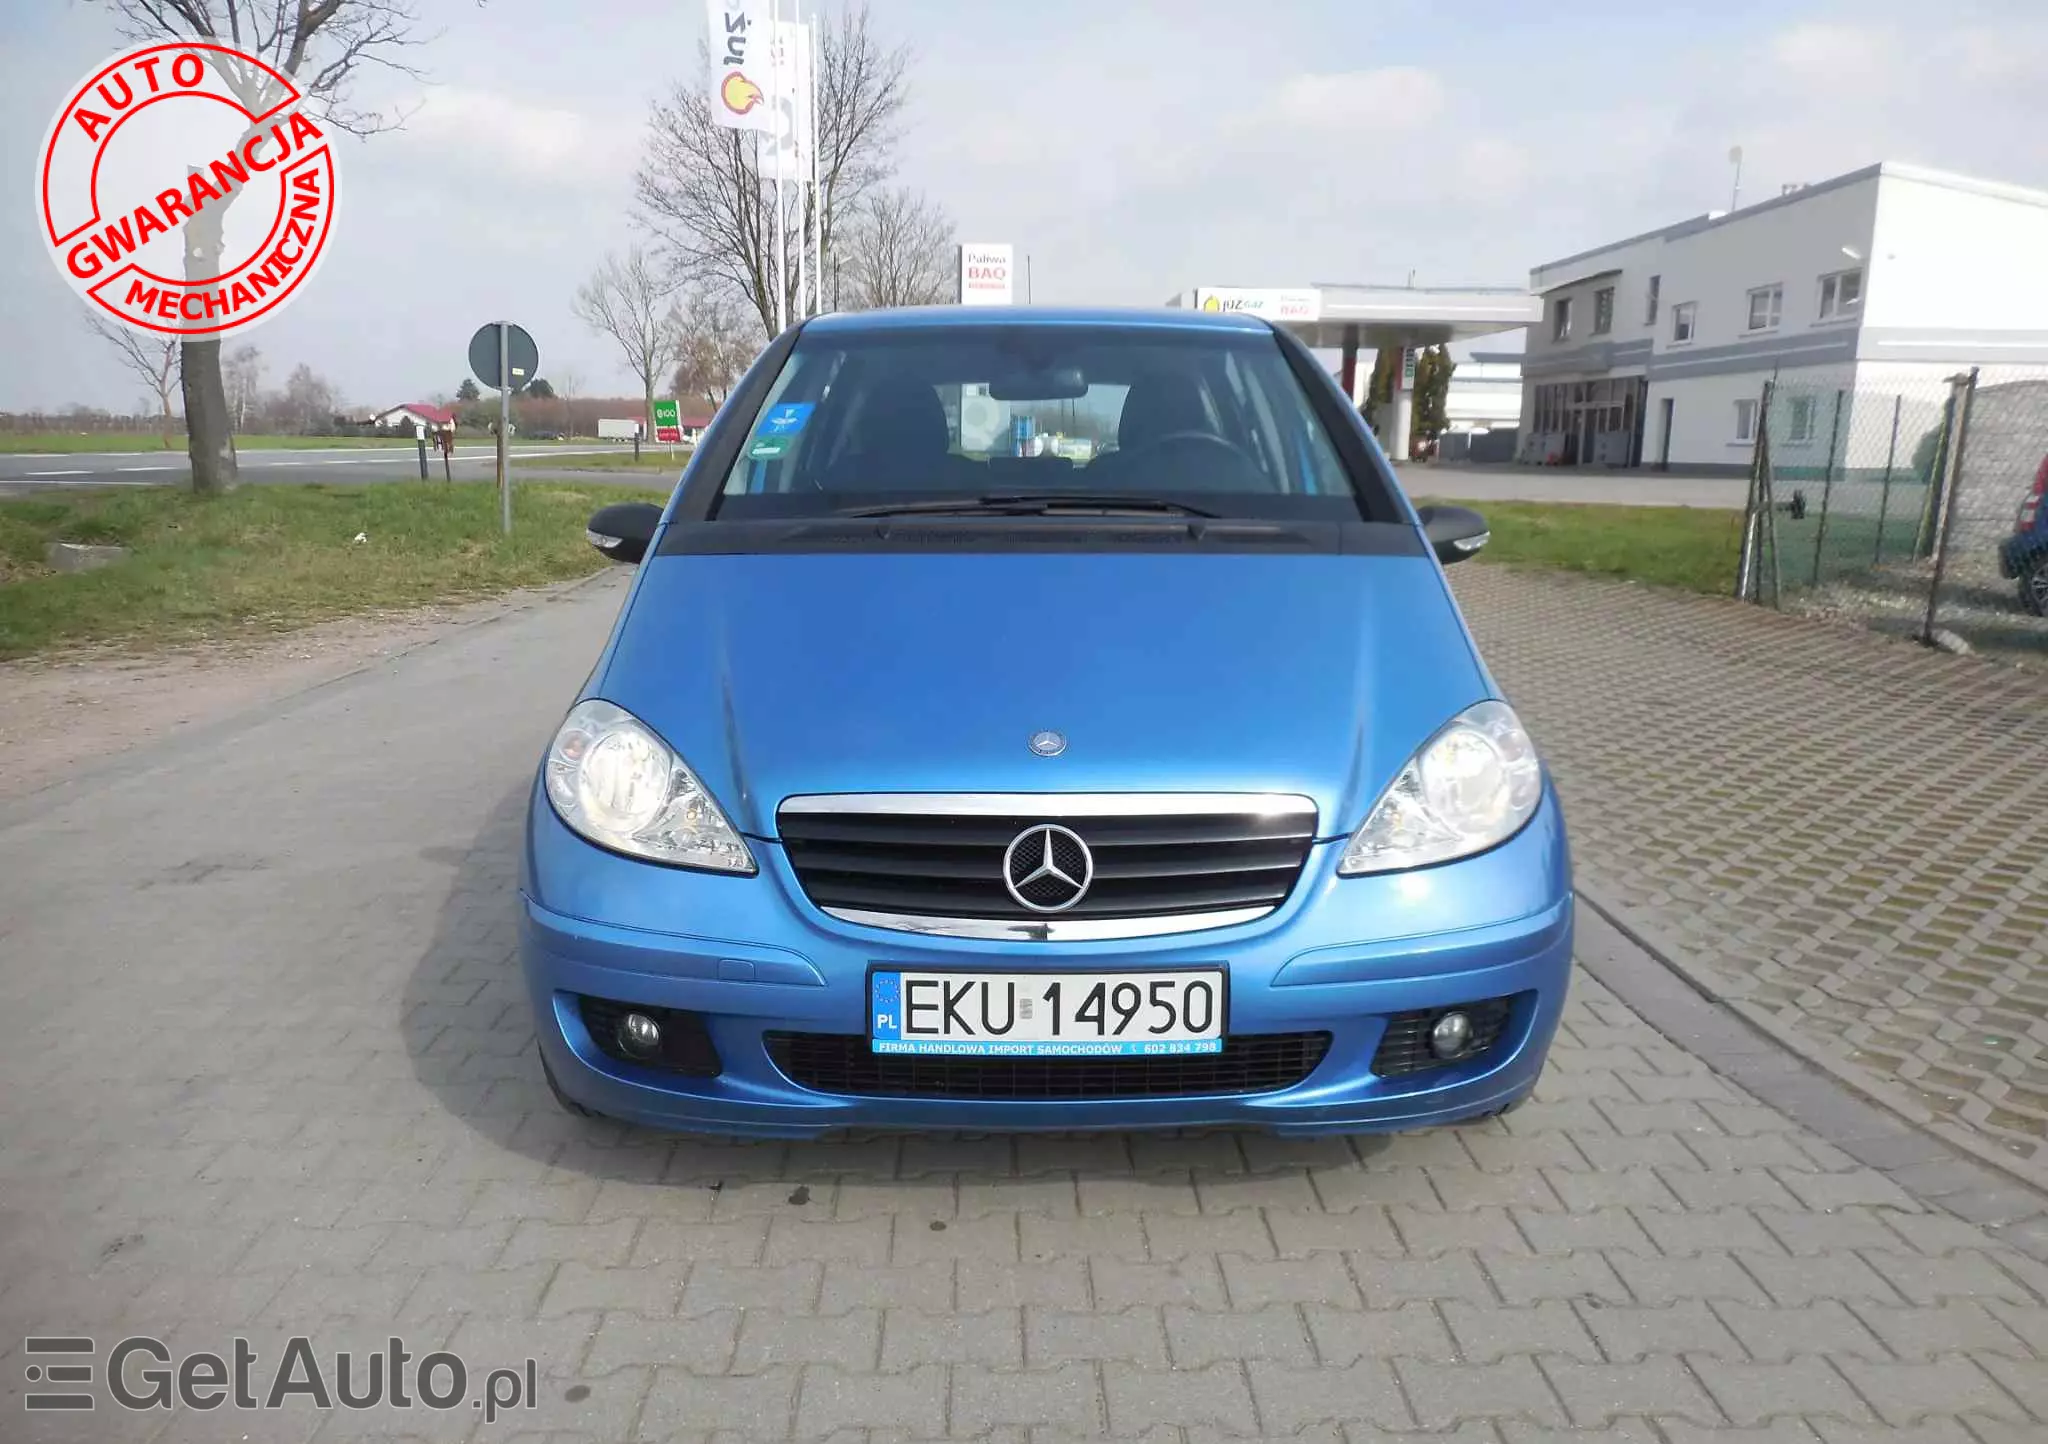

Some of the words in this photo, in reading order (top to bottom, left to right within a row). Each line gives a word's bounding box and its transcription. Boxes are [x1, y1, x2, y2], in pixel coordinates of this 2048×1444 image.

[905, 980, 1015, 1036] EKU
[1043, 980, 1213, 1036] 14950
[877, 1014, 898, 1029] PL
[880, 1042, 916, 1053] FIRMA
[919, 1042, 985, 1055] HANDLOWA
[990, 1044, 1034, 1055] IMPORT
[1037, 1043, 1122, 1056] SAMOCHODÓW
[1144, 1043, 1166, 1054] 602
